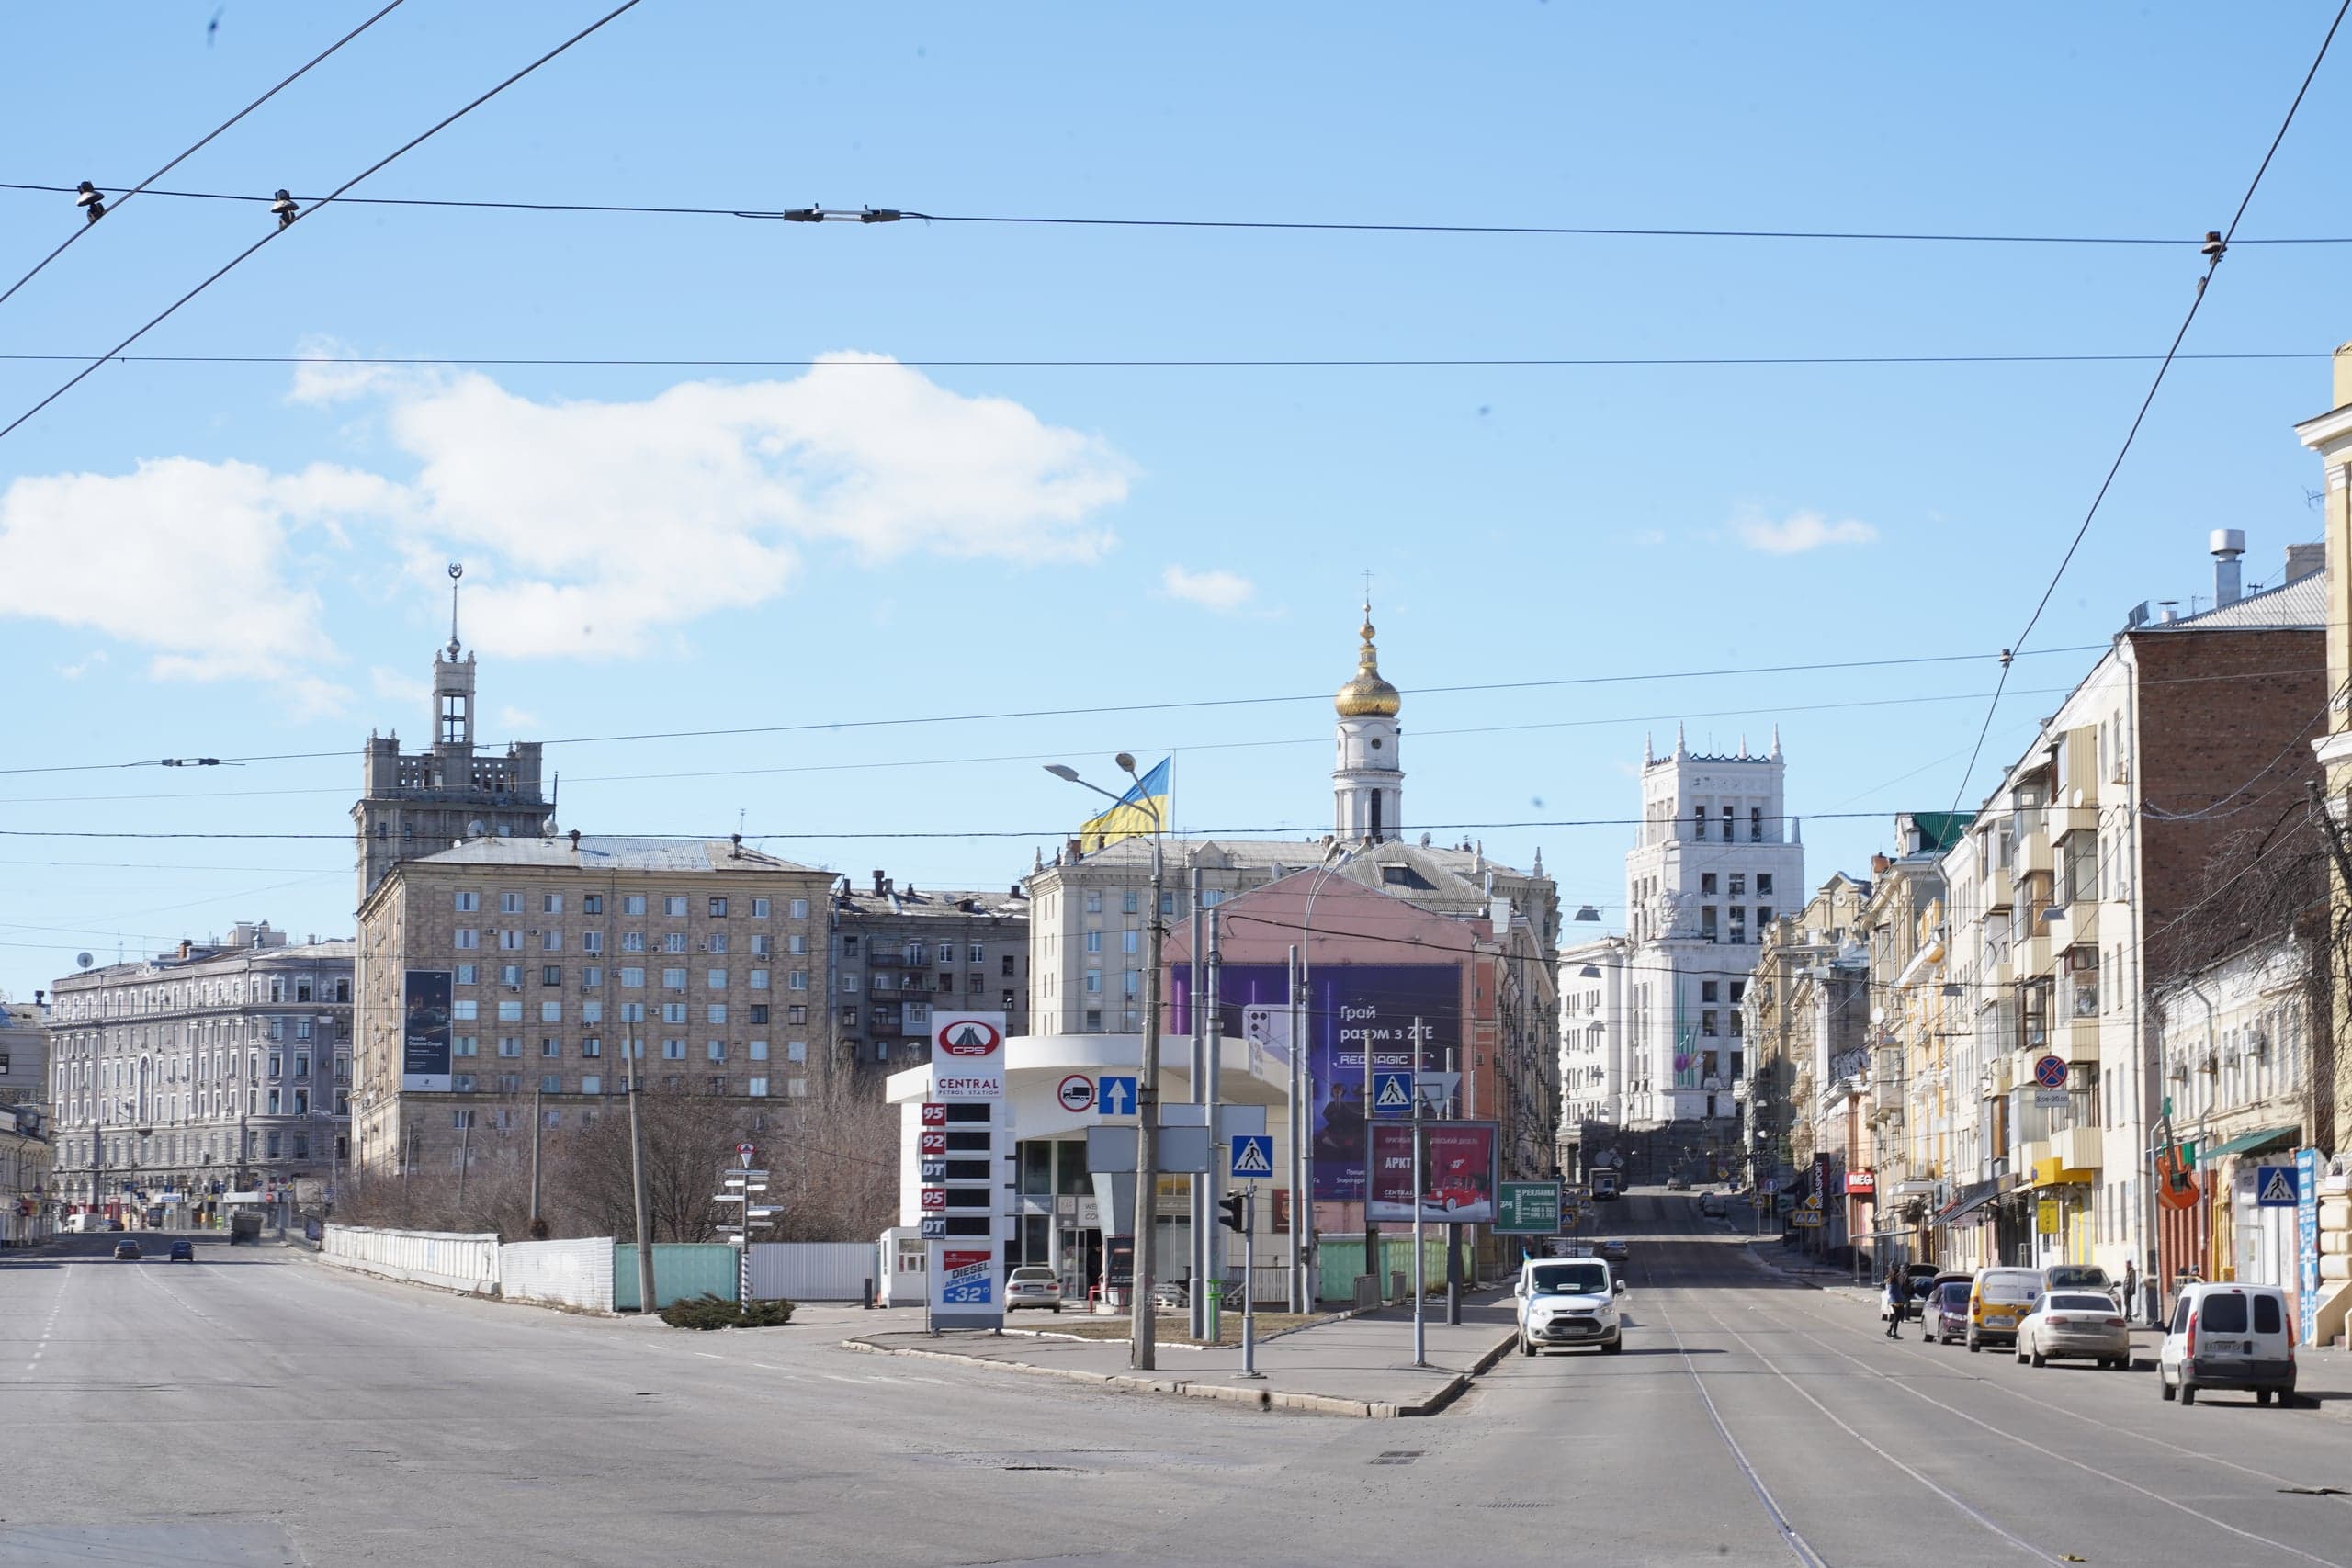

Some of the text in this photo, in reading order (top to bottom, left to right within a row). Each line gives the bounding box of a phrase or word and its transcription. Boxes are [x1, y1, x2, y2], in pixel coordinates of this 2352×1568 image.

[1340, 1005, 1376, 1021] Грай
[1407, 1026, 1433, 1039] ZE
[952, 1046, 986, 1055] CPS
[938, 1078, 1000, 1089] CENTRAL
[923, 1107, 944, 1119] 95
[922, 1135, 944, 1147] 92
[1385, 1157, 1412, 1169] АРКТ
[922, 1164, 944, 1176] DT
[922, 1192, 944, 1204] 95
[922, 1220, 944, 1233] DT
[952, 1262, 989, 1279] DIESEL
[944, 1273, 982, 1288] АРКТИКА
[947, 1287, 989, 1302] -32°
